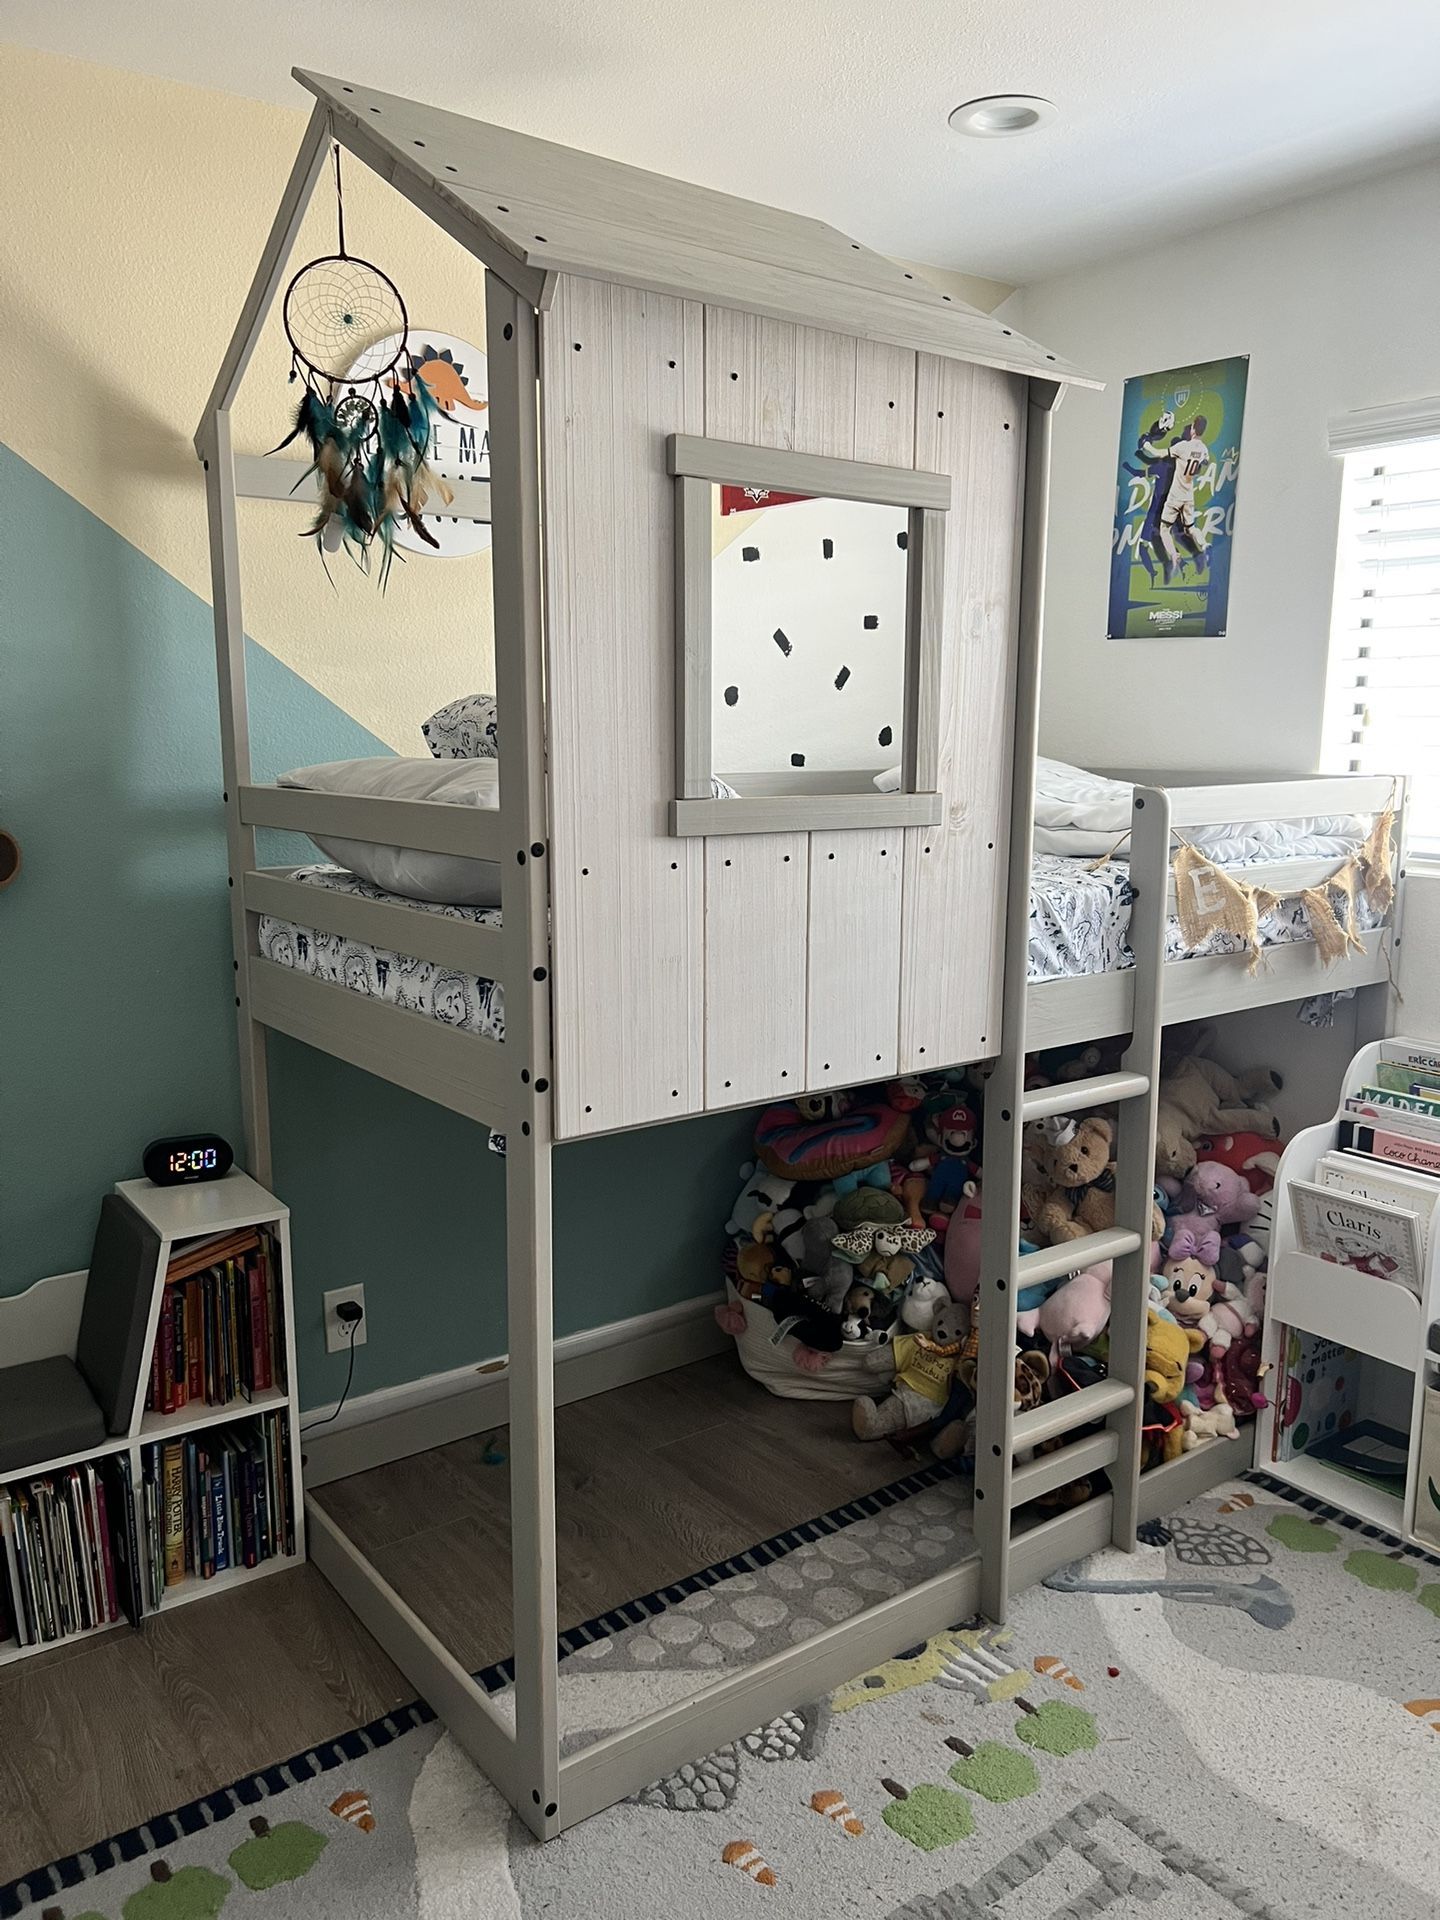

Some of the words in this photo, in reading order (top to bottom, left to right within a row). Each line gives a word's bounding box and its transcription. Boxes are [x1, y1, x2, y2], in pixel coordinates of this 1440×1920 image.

[1184, 459, 1199, 476] 10
[1149, 610, 1183, 620] MESSI
[1188, 867, 1226, 916] E
[1408, 1056, 1427, 1065] ERIC
[170, 1148, 216, 1172] 12:00
[1383, 1146, 1405, 1159] Coco
[1326, 1210, 1382, 1239] Claris
[172, 1466, 182, 1496] HARRY
[173, 1499, 182, 1536] POTTER
